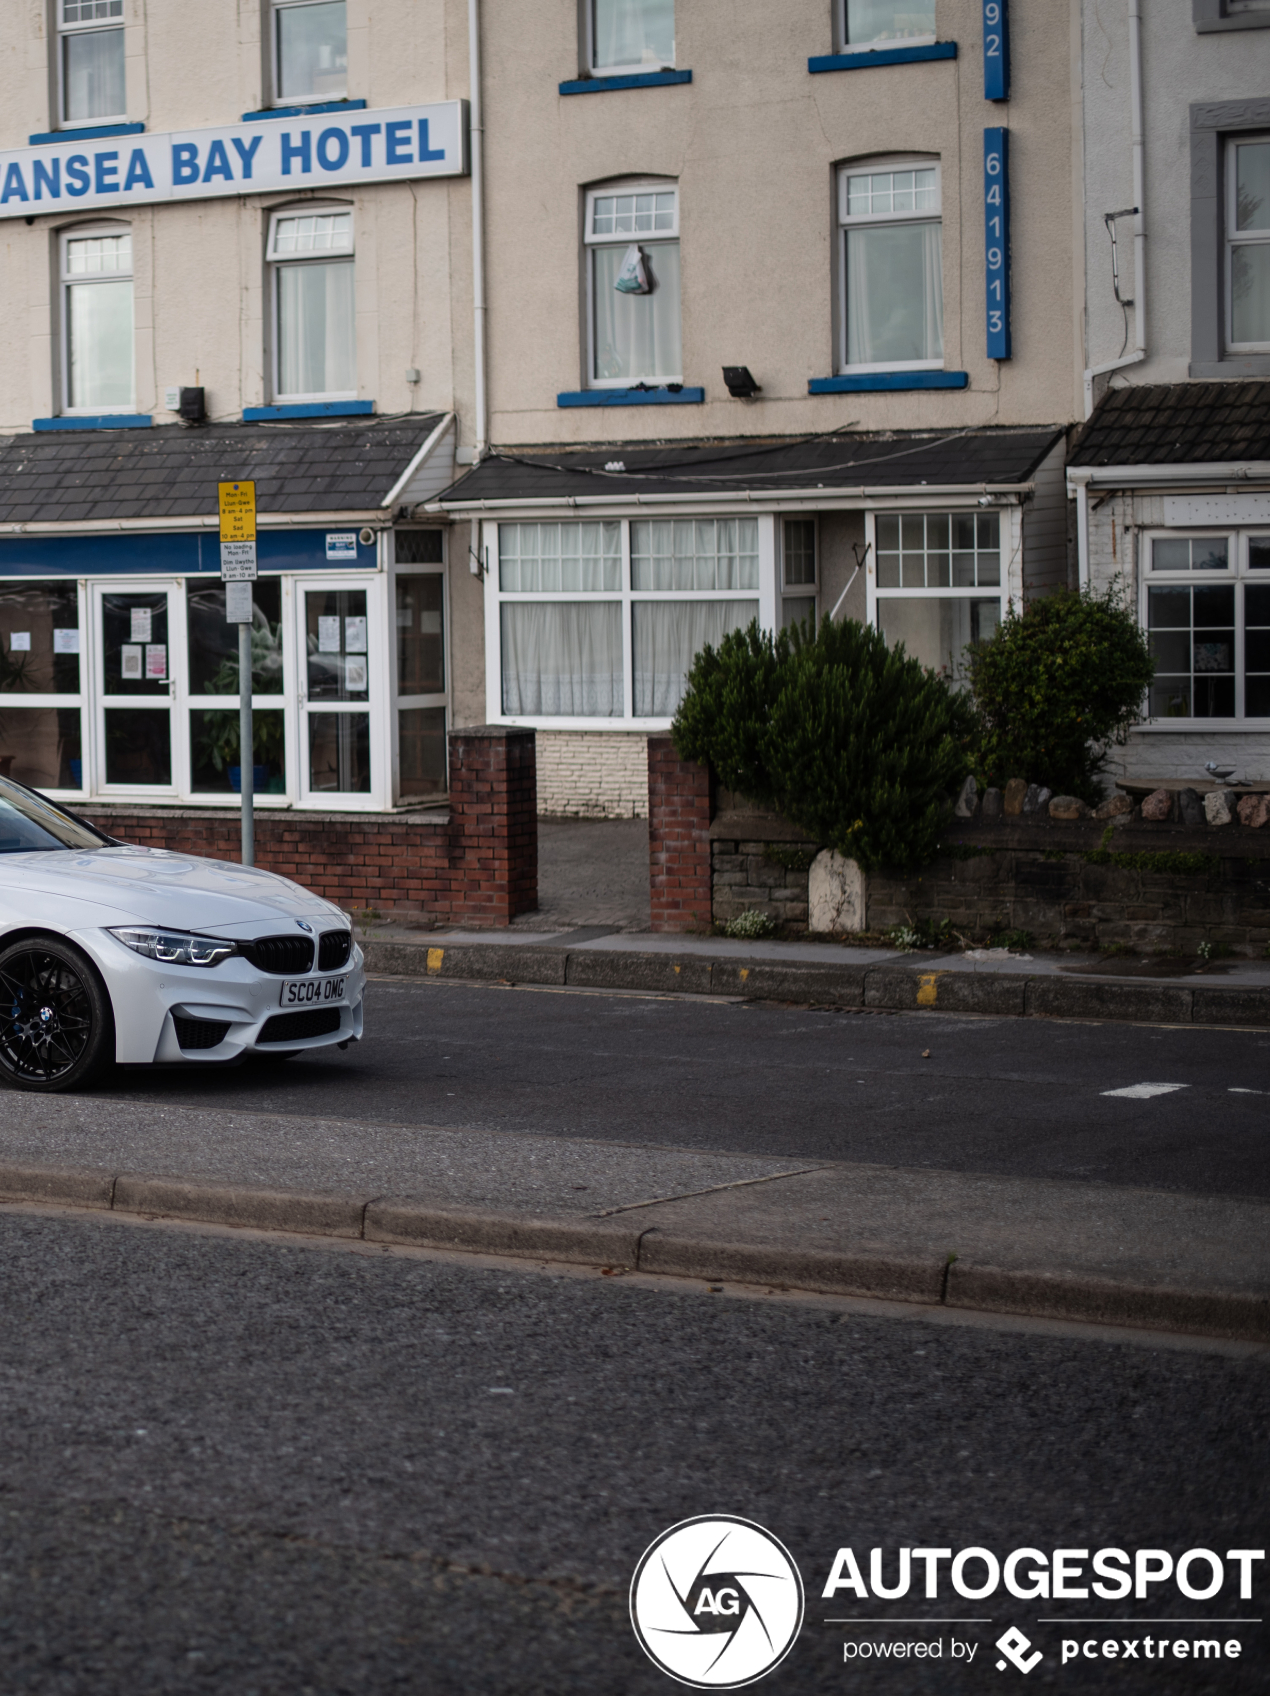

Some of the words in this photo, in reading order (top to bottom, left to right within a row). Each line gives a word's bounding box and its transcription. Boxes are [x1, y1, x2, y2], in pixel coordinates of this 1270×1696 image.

[171, 135, 264, 186] BAY
[280, 118, 446, 176] HOTEL
[986, 152, 1002, 333] 641913
[287, 981, 322, 1003] SC04
[324, 978, 345, 1000] OMG
